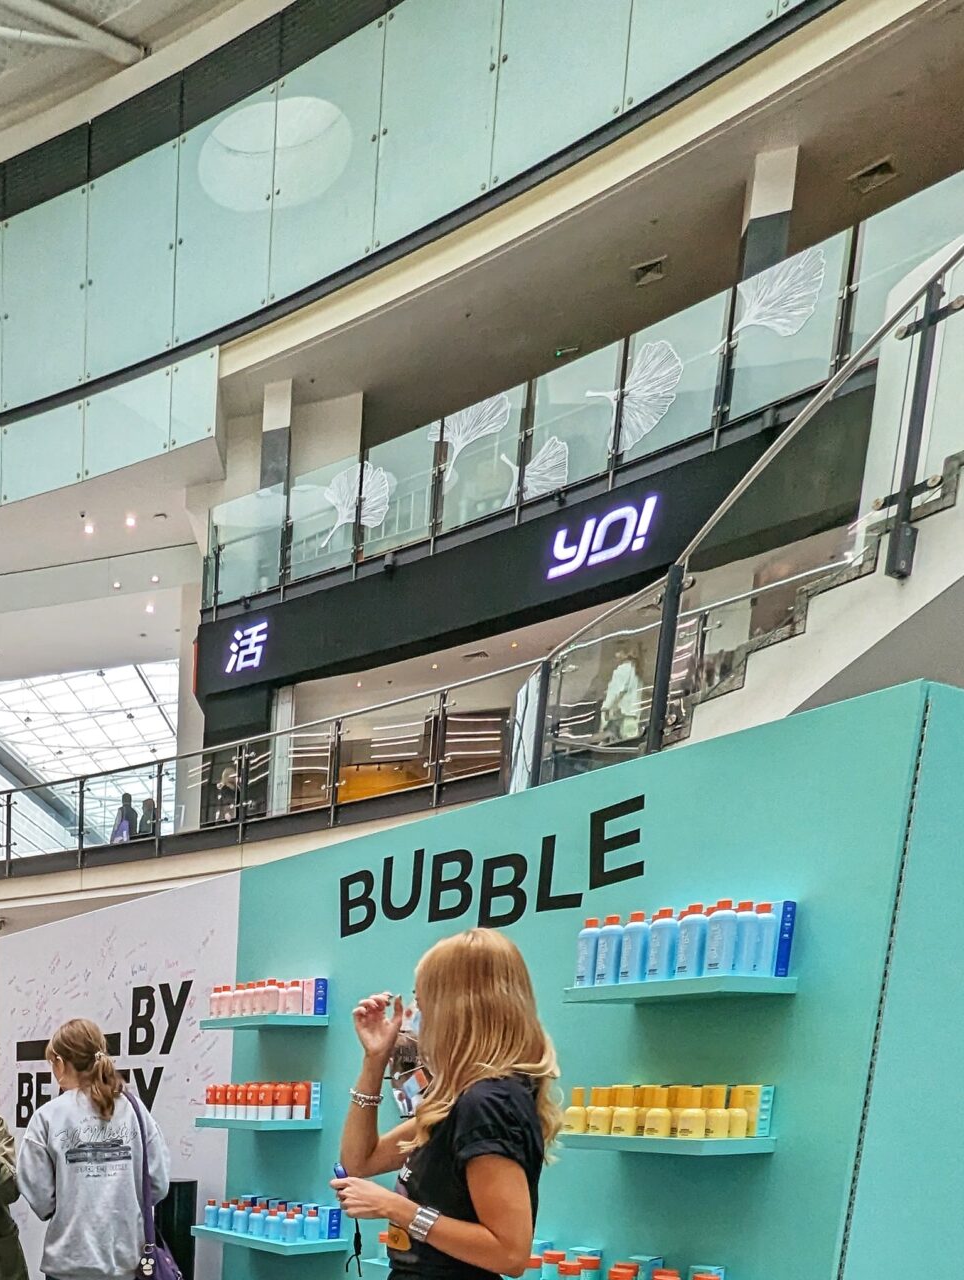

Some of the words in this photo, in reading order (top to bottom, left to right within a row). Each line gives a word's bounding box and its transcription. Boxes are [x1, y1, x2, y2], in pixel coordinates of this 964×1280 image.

[225, 621, 268, 674] 活
[340, 794, 645, 938] BUBBLE
[128, 980, 193, 1056] BY
